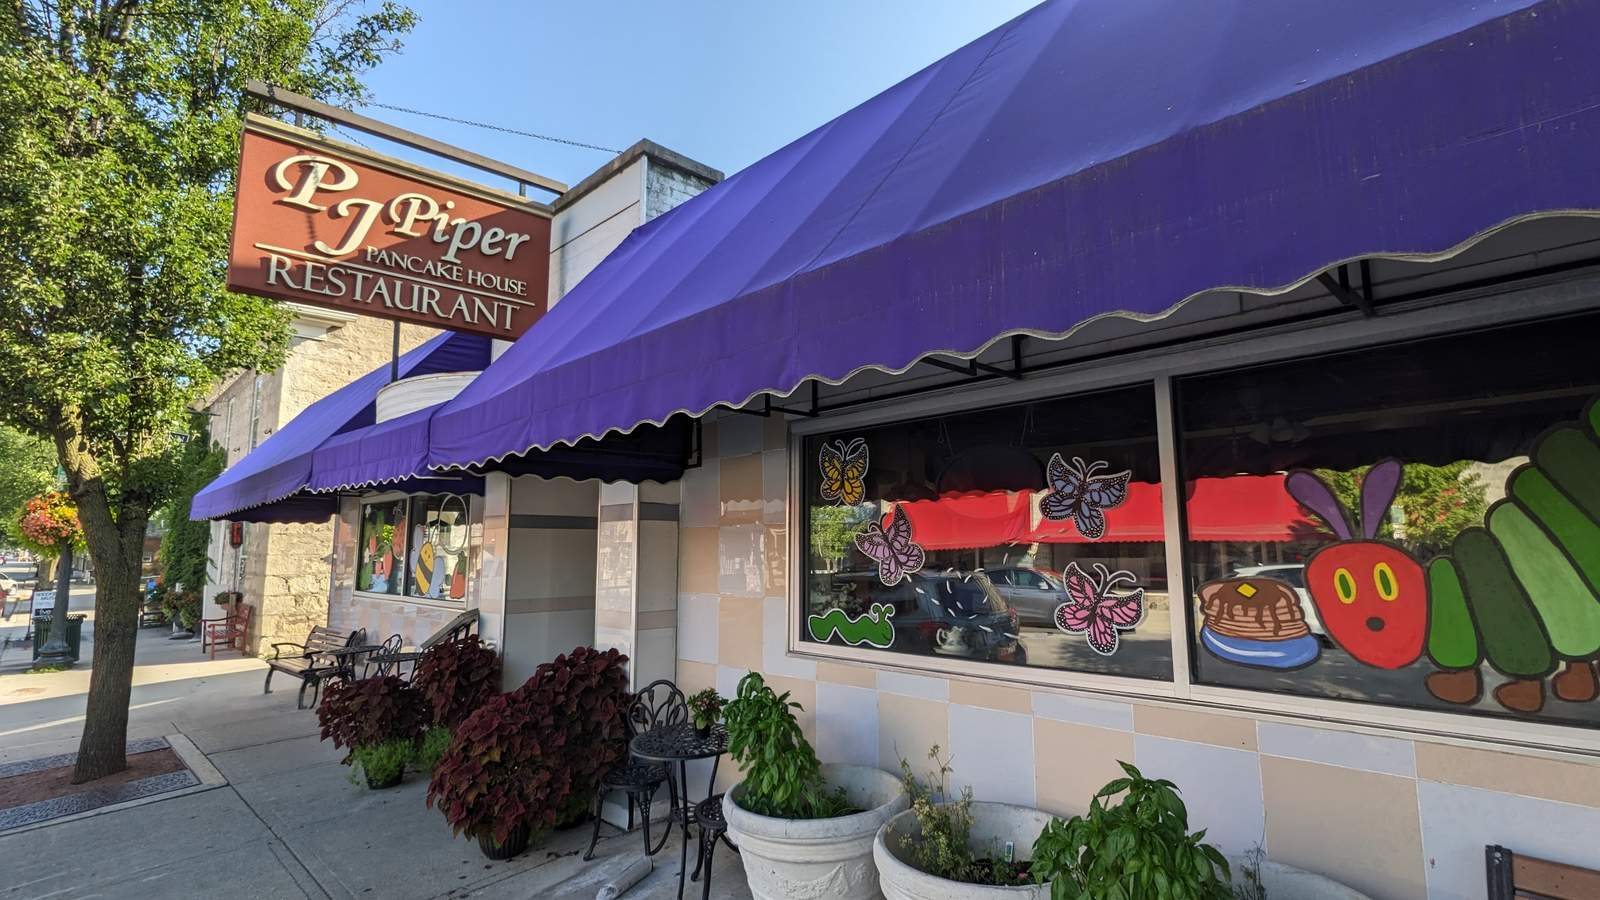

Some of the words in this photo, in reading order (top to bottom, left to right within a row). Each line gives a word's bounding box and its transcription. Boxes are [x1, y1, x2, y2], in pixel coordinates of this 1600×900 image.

[389, 193, 530, 264] Piper
[266, 254, 520, 330] RESTAURANT
[366, 245, 463, 282] PANCAKE
[467, 271, 527, 296] HOUSE
